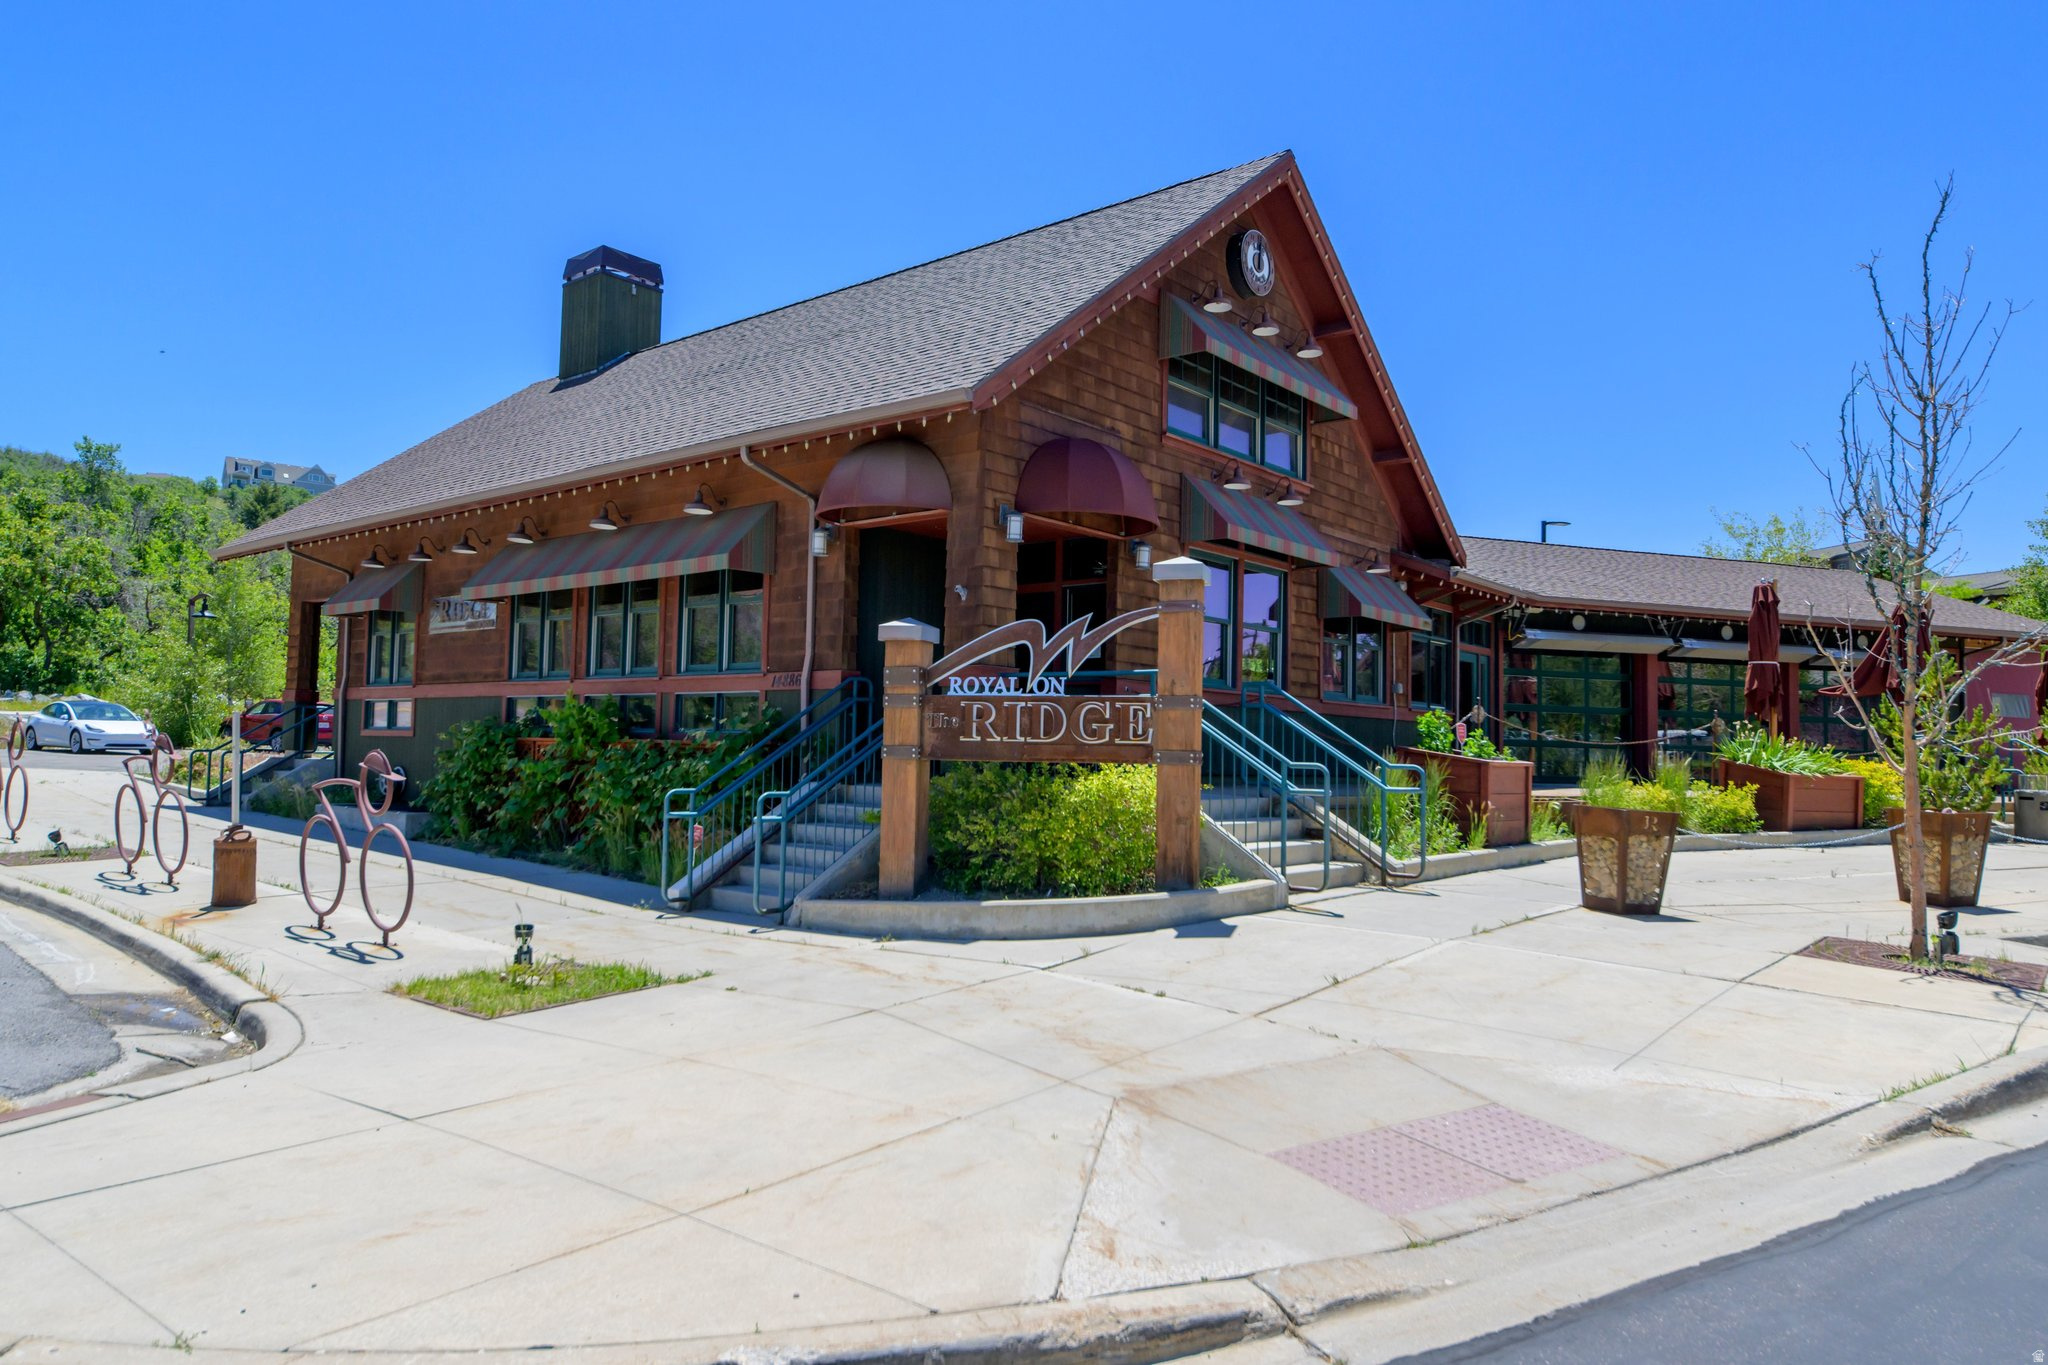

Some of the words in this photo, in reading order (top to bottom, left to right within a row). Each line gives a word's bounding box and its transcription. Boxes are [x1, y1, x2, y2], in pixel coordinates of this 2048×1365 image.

[947, 676, 1023, 696] ROYAL
[1032, 676, 1067, 696] ON
[927, 712, 959, 728] The
[959, 700, 1154, 744] RIDGE
